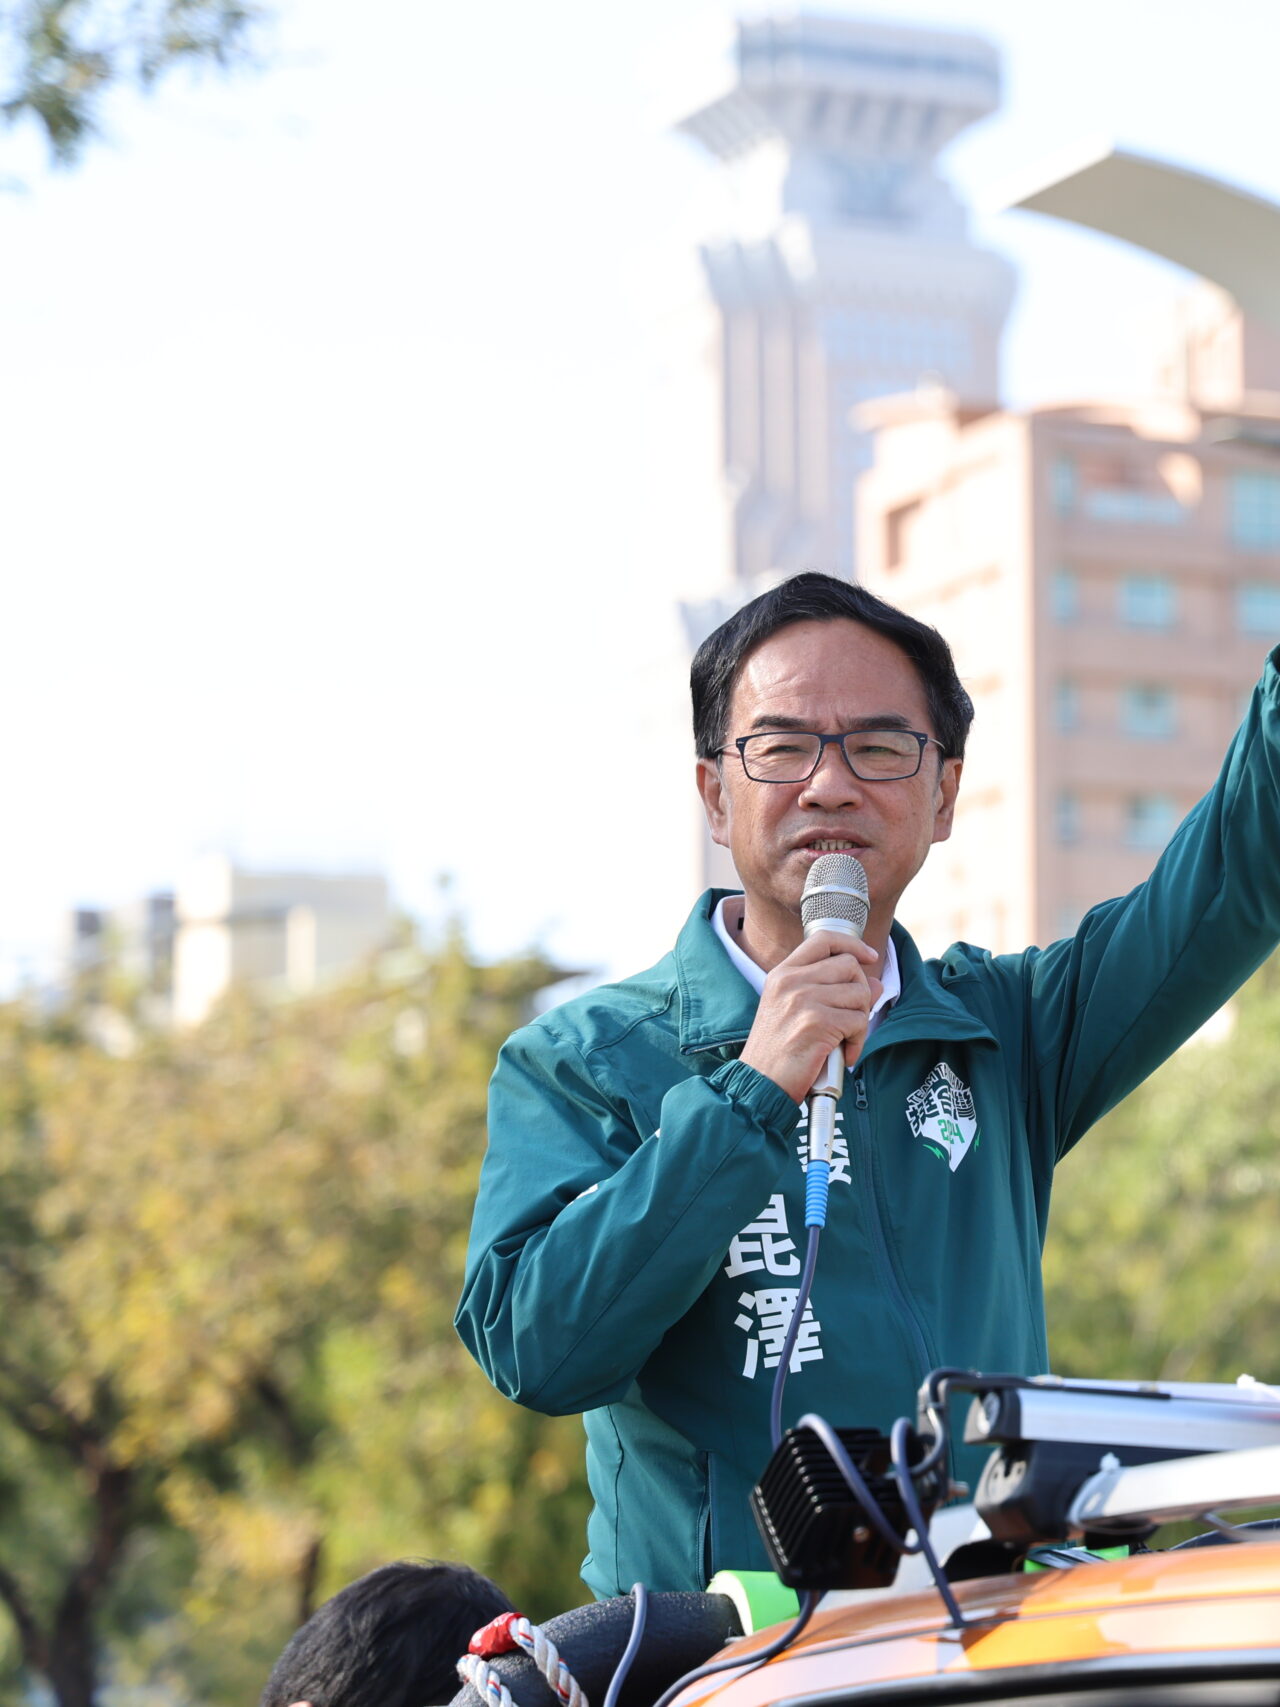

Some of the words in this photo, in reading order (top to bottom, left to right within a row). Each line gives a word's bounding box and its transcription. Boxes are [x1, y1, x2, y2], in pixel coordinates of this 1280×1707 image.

[906, 1071, 939, 1106] TEAM
[934, 1062, 965, 1091] TAAN
[905, 1086, 977, 1138] 挺台灣
[725, 1194, 824, 1379] 昆澤
